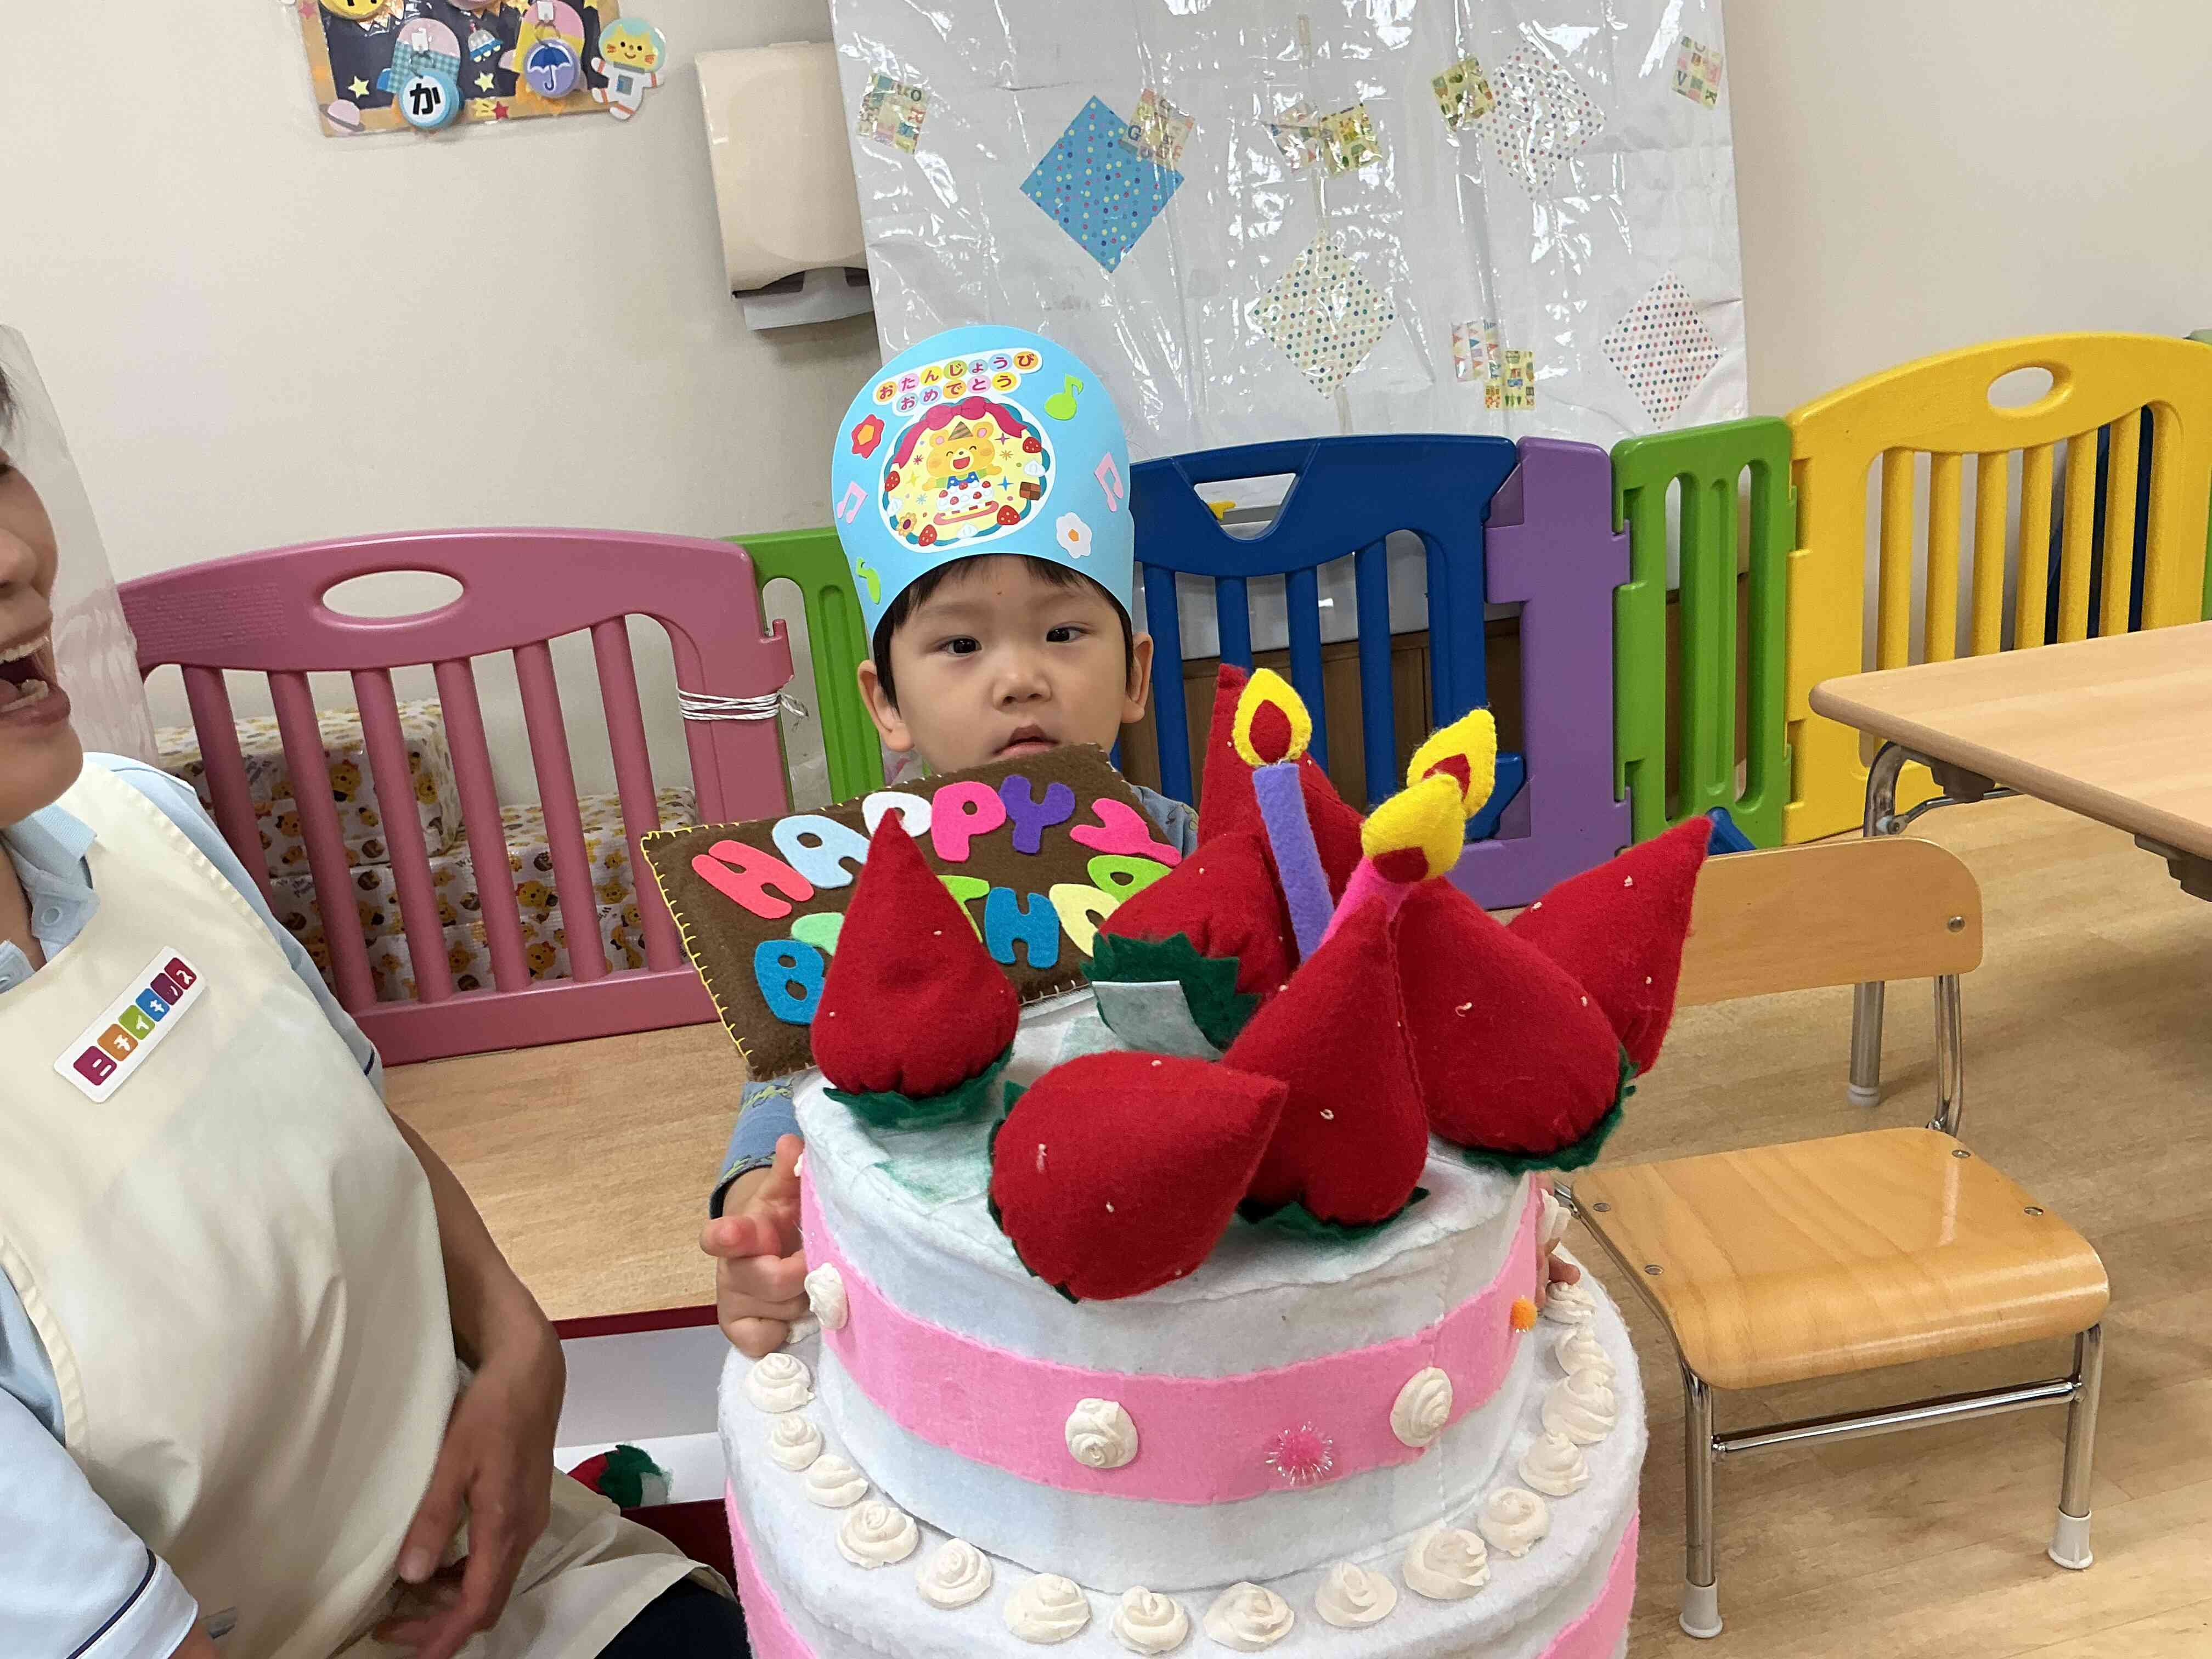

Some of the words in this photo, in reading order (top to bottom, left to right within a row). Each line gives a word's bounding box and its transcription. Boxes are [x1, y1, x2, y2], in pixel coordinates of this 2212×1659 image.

[410, 83, 441, 115] か
[879, 353, 1035, 400] おたんじょうび
[900, 375, 1012, 410] おめでとう
